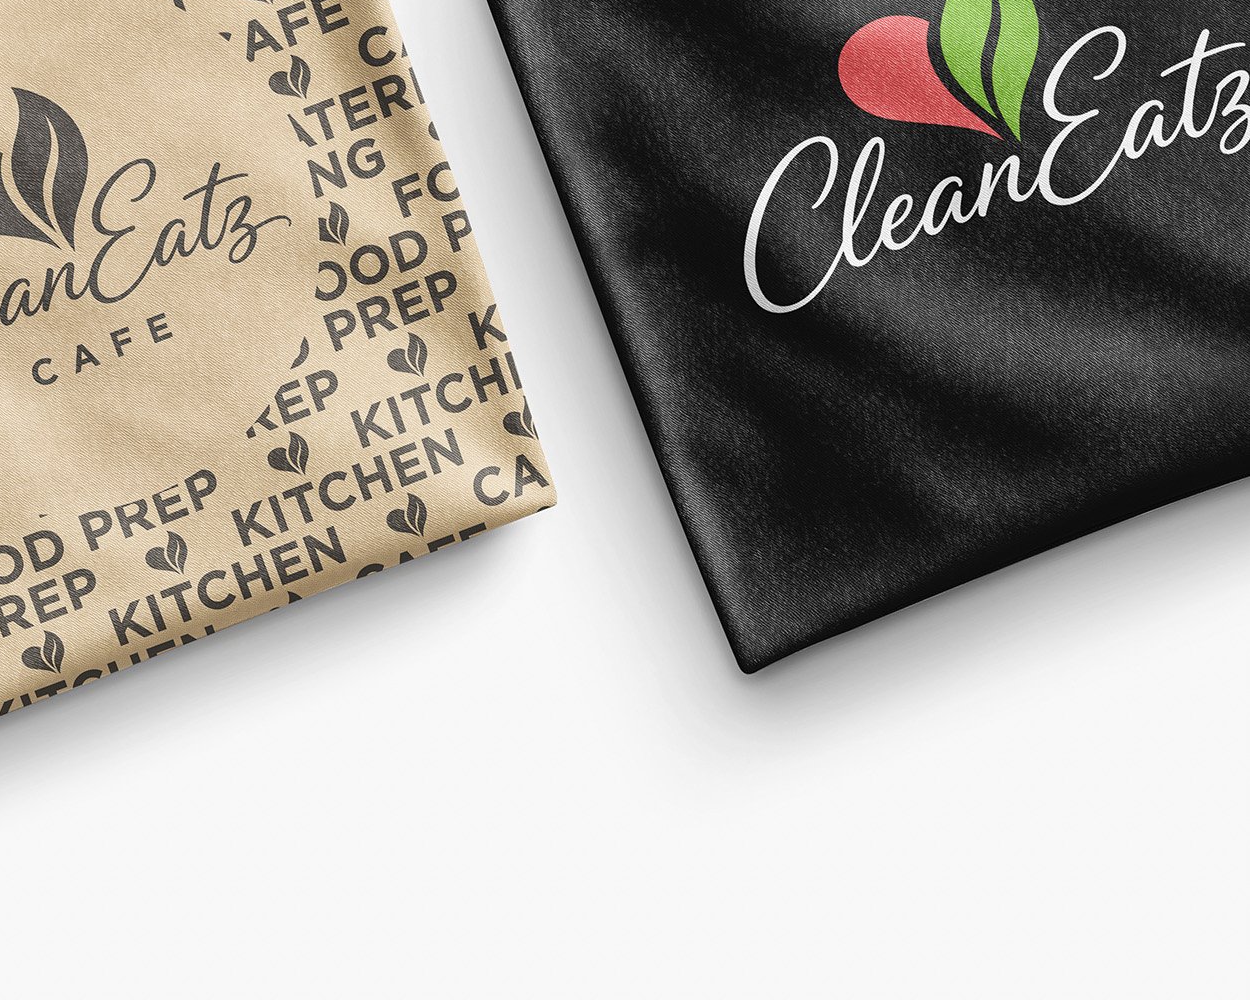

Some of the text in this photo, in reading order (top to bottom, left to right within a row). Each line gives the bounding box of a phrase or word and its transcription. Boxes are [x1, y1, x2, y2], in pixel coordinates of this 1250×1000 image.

[743, 25, 1250, 313] CleanEatz
[31, 312, 173, 386] CAFE
[323, 269, 459, 352] PREP
[78, 468, 218, 551] PREP
[230, 428, 465, 548] KITCHEN
[108, 525, 348, 647] KITCHEN
